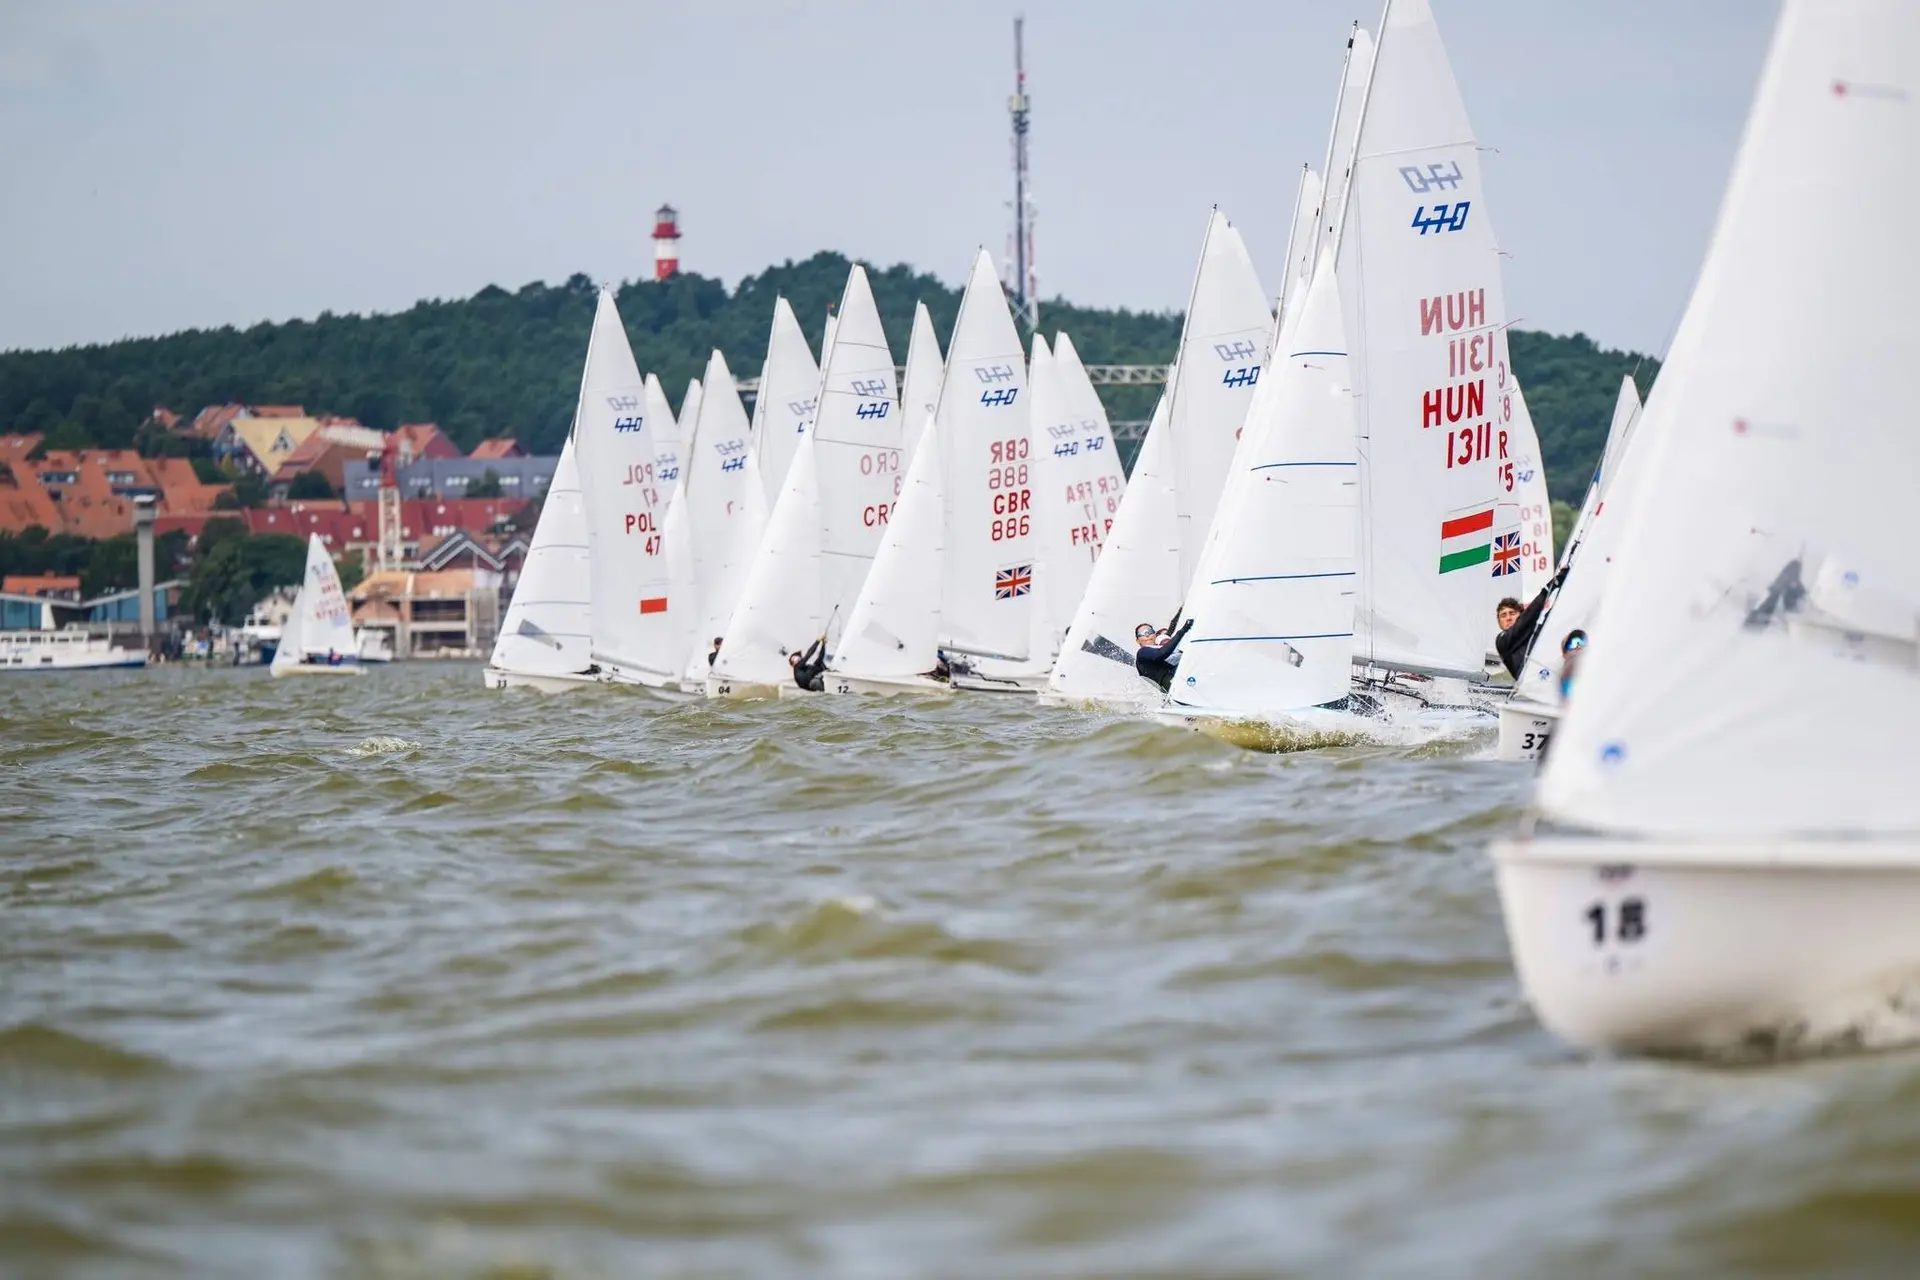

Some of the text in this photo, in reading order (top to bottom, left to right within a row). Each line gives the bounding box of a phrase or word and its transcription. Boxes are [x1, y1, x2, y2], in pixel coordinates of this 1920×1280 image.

[1411, 201, 1470, 235] 470
[1223, 365, 1261, 388] 470
[981, 388, 1018, 407] 470
[1423, 379, 1484, 428] HUN
[856, 402, 889, 420] 470
[615, 417, 643, 433] 470
[1054, 441, 1079, 457] 470
[1085, 436, 1104, 451] 70
[1447, 422, 1491, 469] 1311
[993, 489, 1031, 515] GBR
[625, 512, 656, 534] POL
[992, 515, 1030, 541] 886
[1071, 523, 1099, 546] FRA
[645, 535, 661, 556] 47
[1522, 541, 1542, 557] OL
[718, 686, 731, 695] 04
[838, 685, 849, 694] 12
[1522, 733, 1550, 751] 37
[1584, 898, 1647, 945] 18
